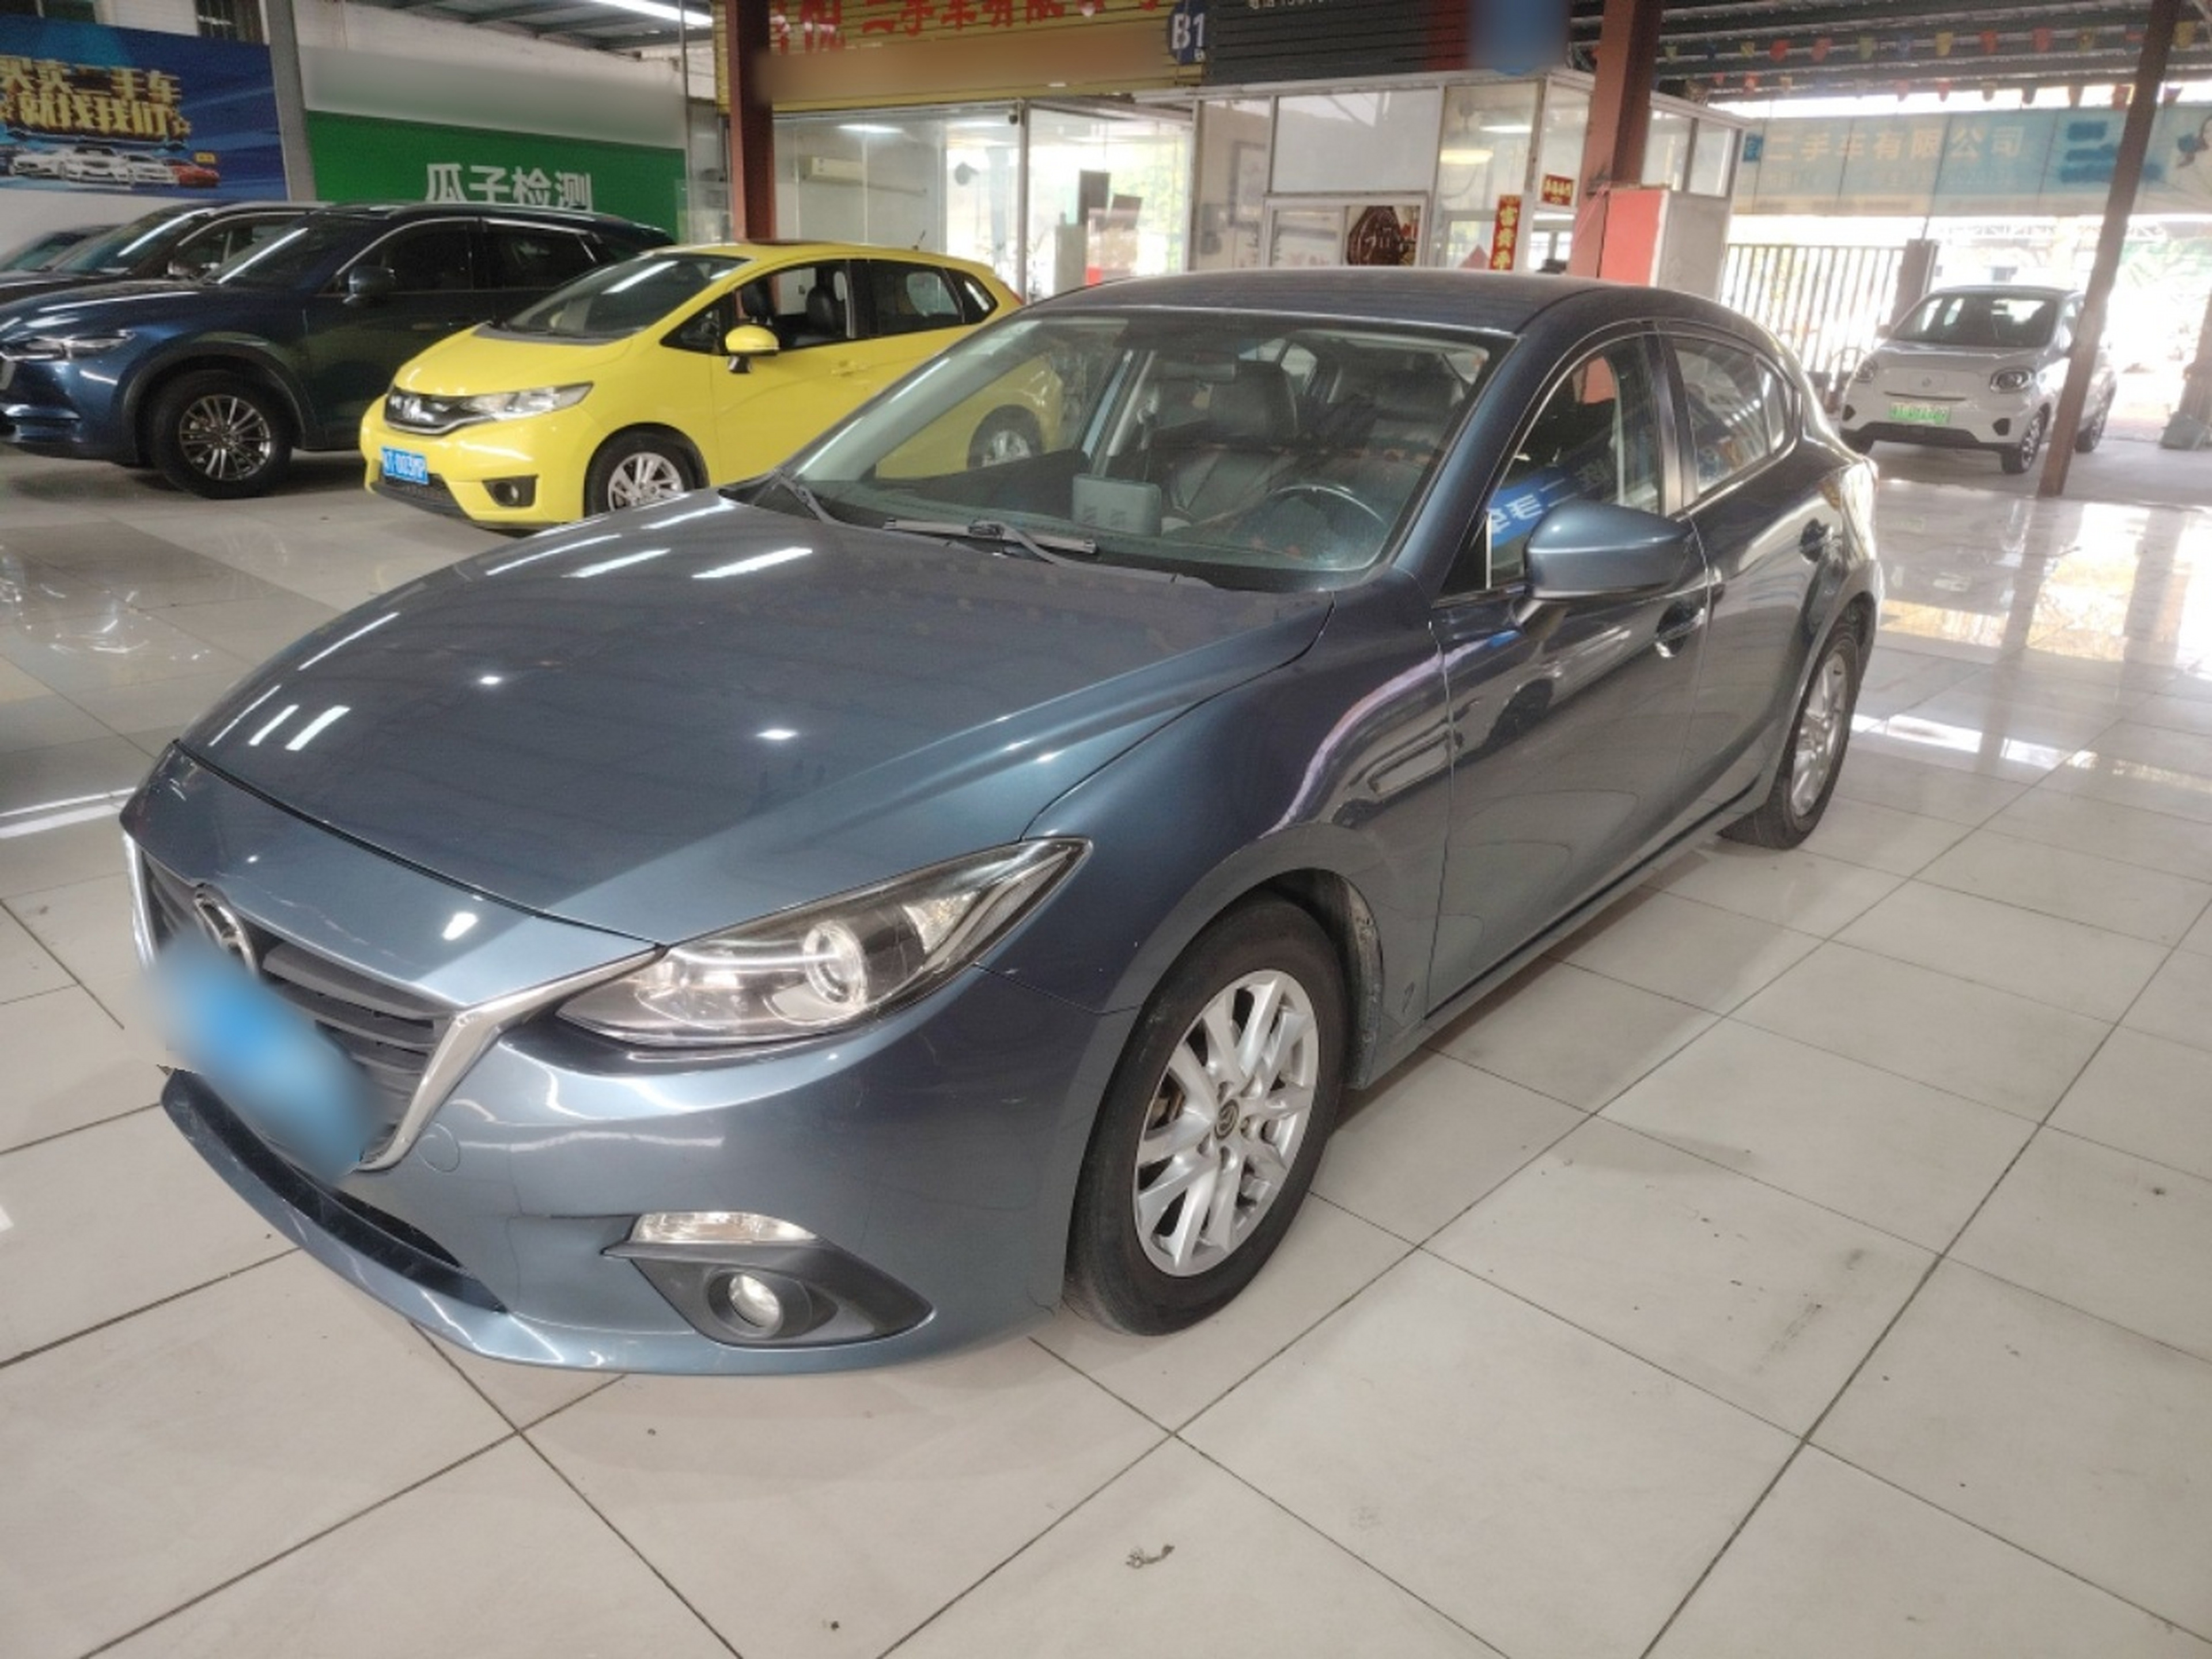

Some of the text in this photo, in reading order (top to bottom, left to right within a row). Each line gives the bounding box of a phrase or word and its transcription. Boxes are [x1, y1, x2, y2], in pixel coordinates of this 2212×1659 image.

[1172, 13, 1205, 50] B1
[1766, 126, 2025, 162] 二手车有限公司
[425, 163, 593, 212] 瓜子检测
